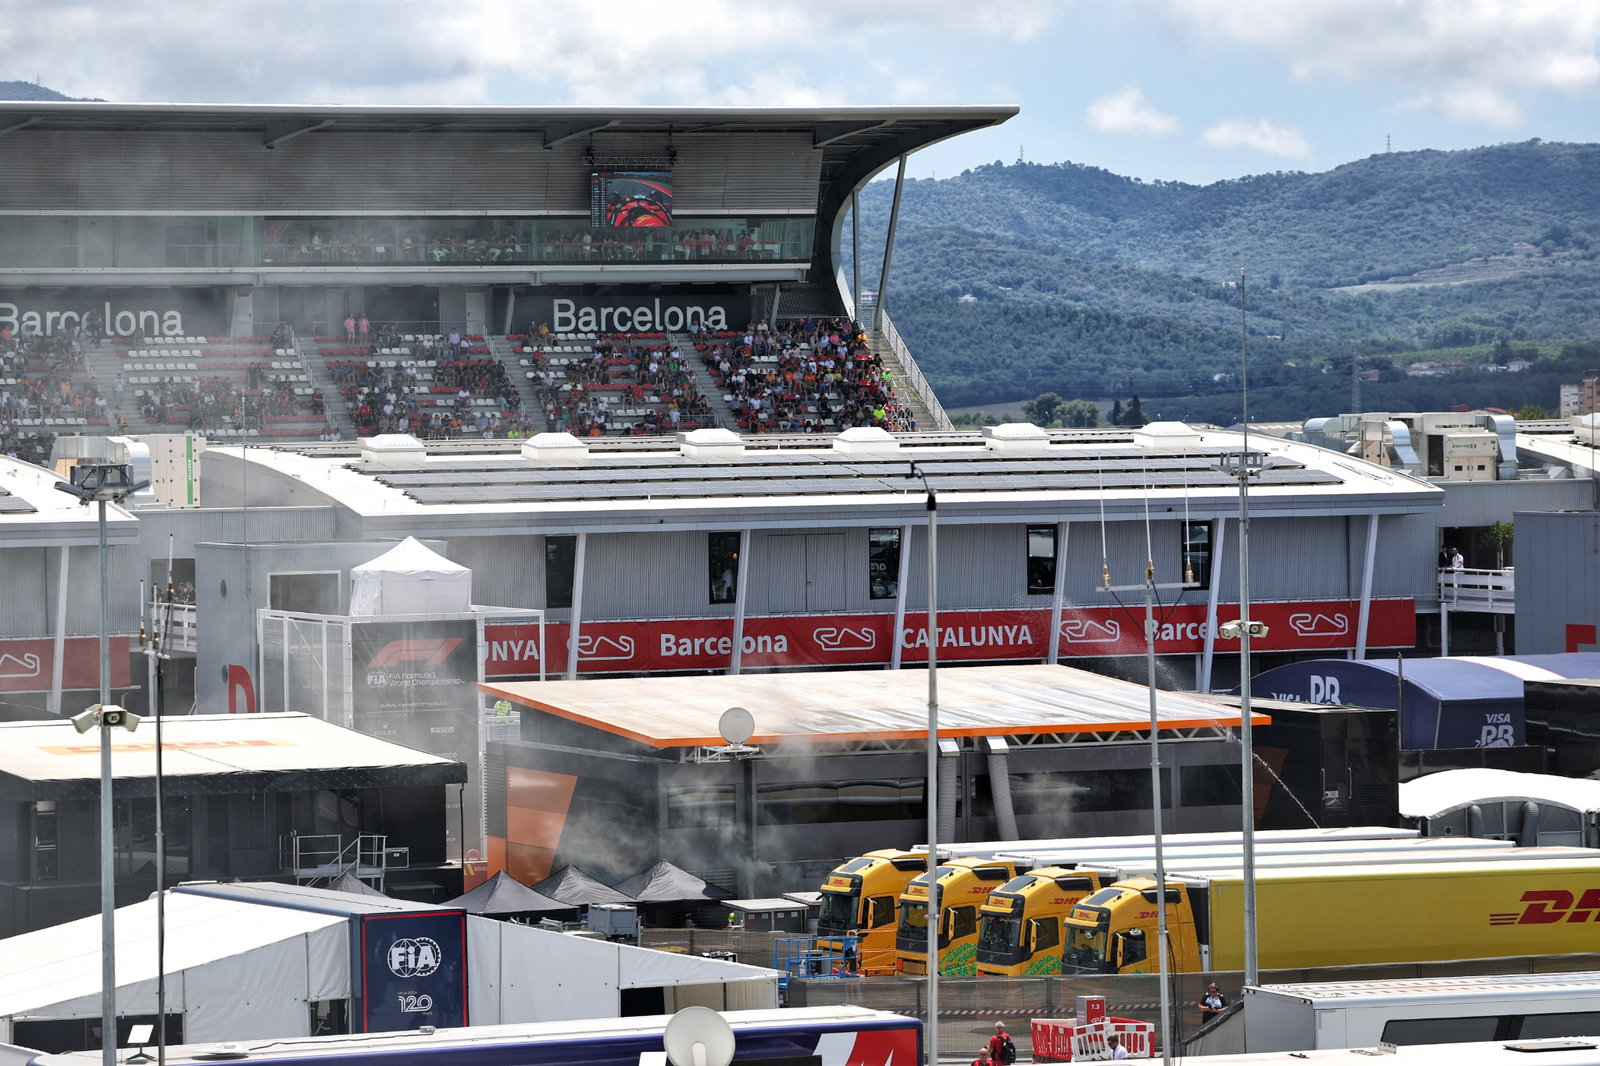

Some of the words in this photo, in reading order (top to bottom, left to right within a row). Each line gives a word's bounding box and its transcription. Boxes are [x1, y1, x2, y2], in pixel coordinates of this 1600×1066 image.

[553, 298, 727, 332] Barcelona
[660, 634, 788, 657] Barceona
[1484, 713, 1511, 723] VISA
[398, 995, 433, 1012] 120
